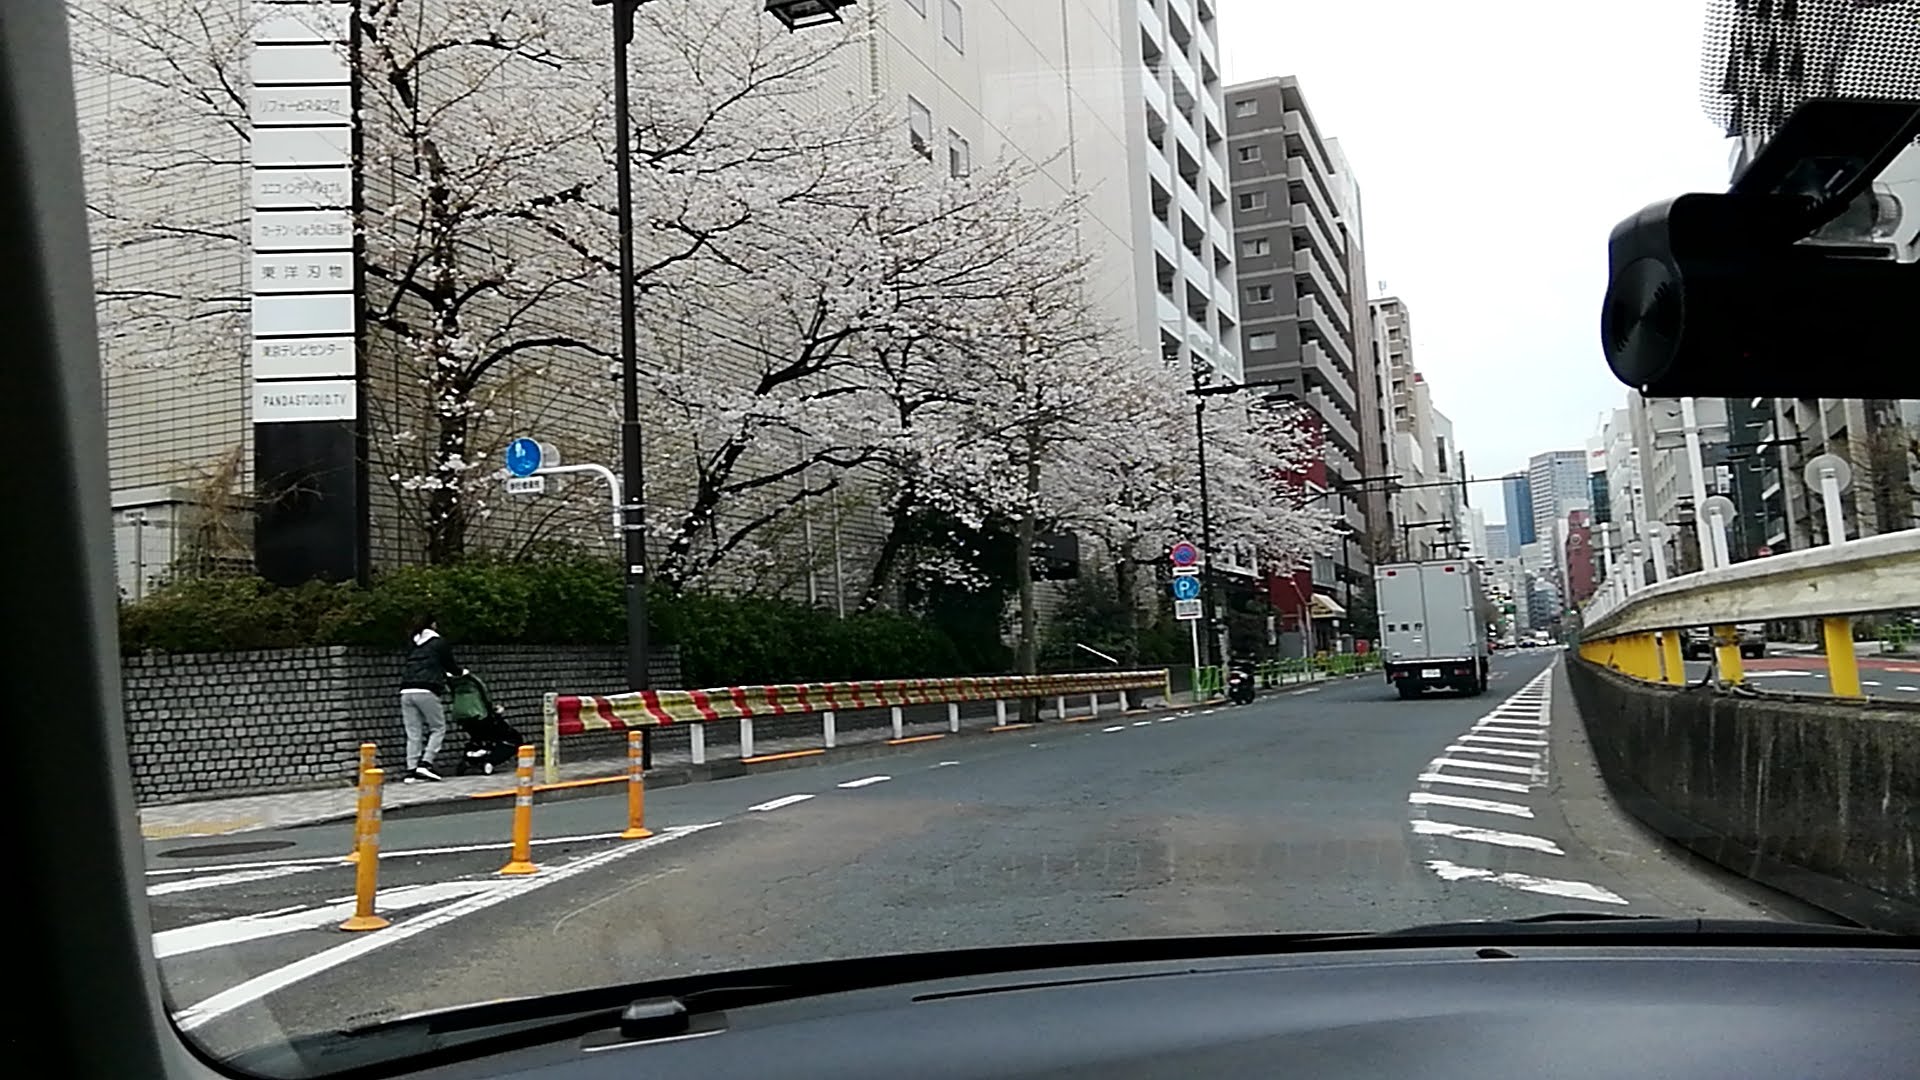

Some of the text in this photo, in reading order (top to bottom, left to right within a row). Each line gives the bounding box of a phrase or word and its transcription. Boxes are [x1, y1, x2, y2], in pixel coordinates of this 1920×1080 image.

[262, 265, 343, 279] 東洋刃物
[262, 344, 344, 357] 東京テレビセンター
